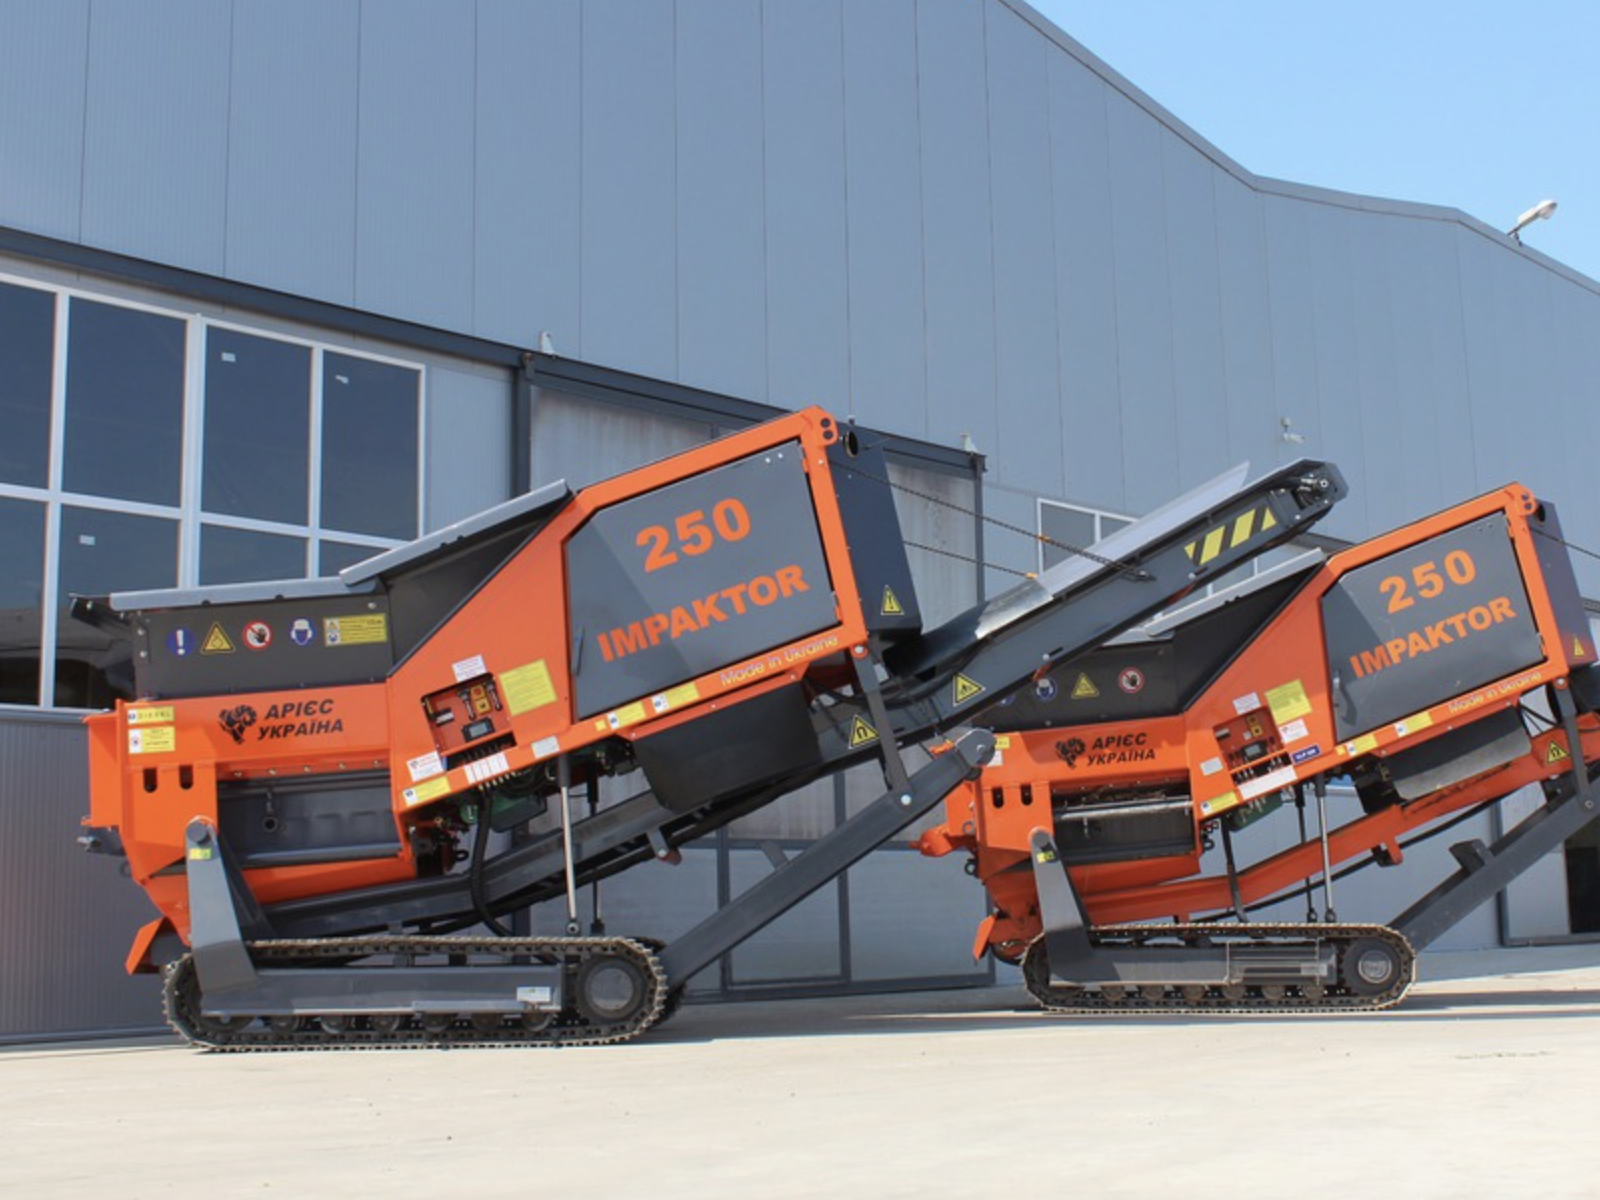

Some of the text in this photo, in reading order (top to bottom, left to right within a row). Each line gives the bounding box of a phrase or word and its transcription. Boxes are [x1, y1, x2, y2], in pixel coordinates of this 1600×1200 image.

[636, 497, 752, 573] 250
[1379, 549, 1476, 614] 250
[596, 563, 811, 663] IMPAKTOR
[1350, 596, 1516, 678] IMPAKTOR
[719, 635, 839, 687] Made in Ukraine
[263, 698, 335, 721] АРІЄС
[1448, 691, 1485, 714] Made
[257, 718, 345, 741] УКРАЇНА
[1091, 731, 1148, 750] АРІЄС
[1086, 748, 1156, 767] УКРАЇНА
